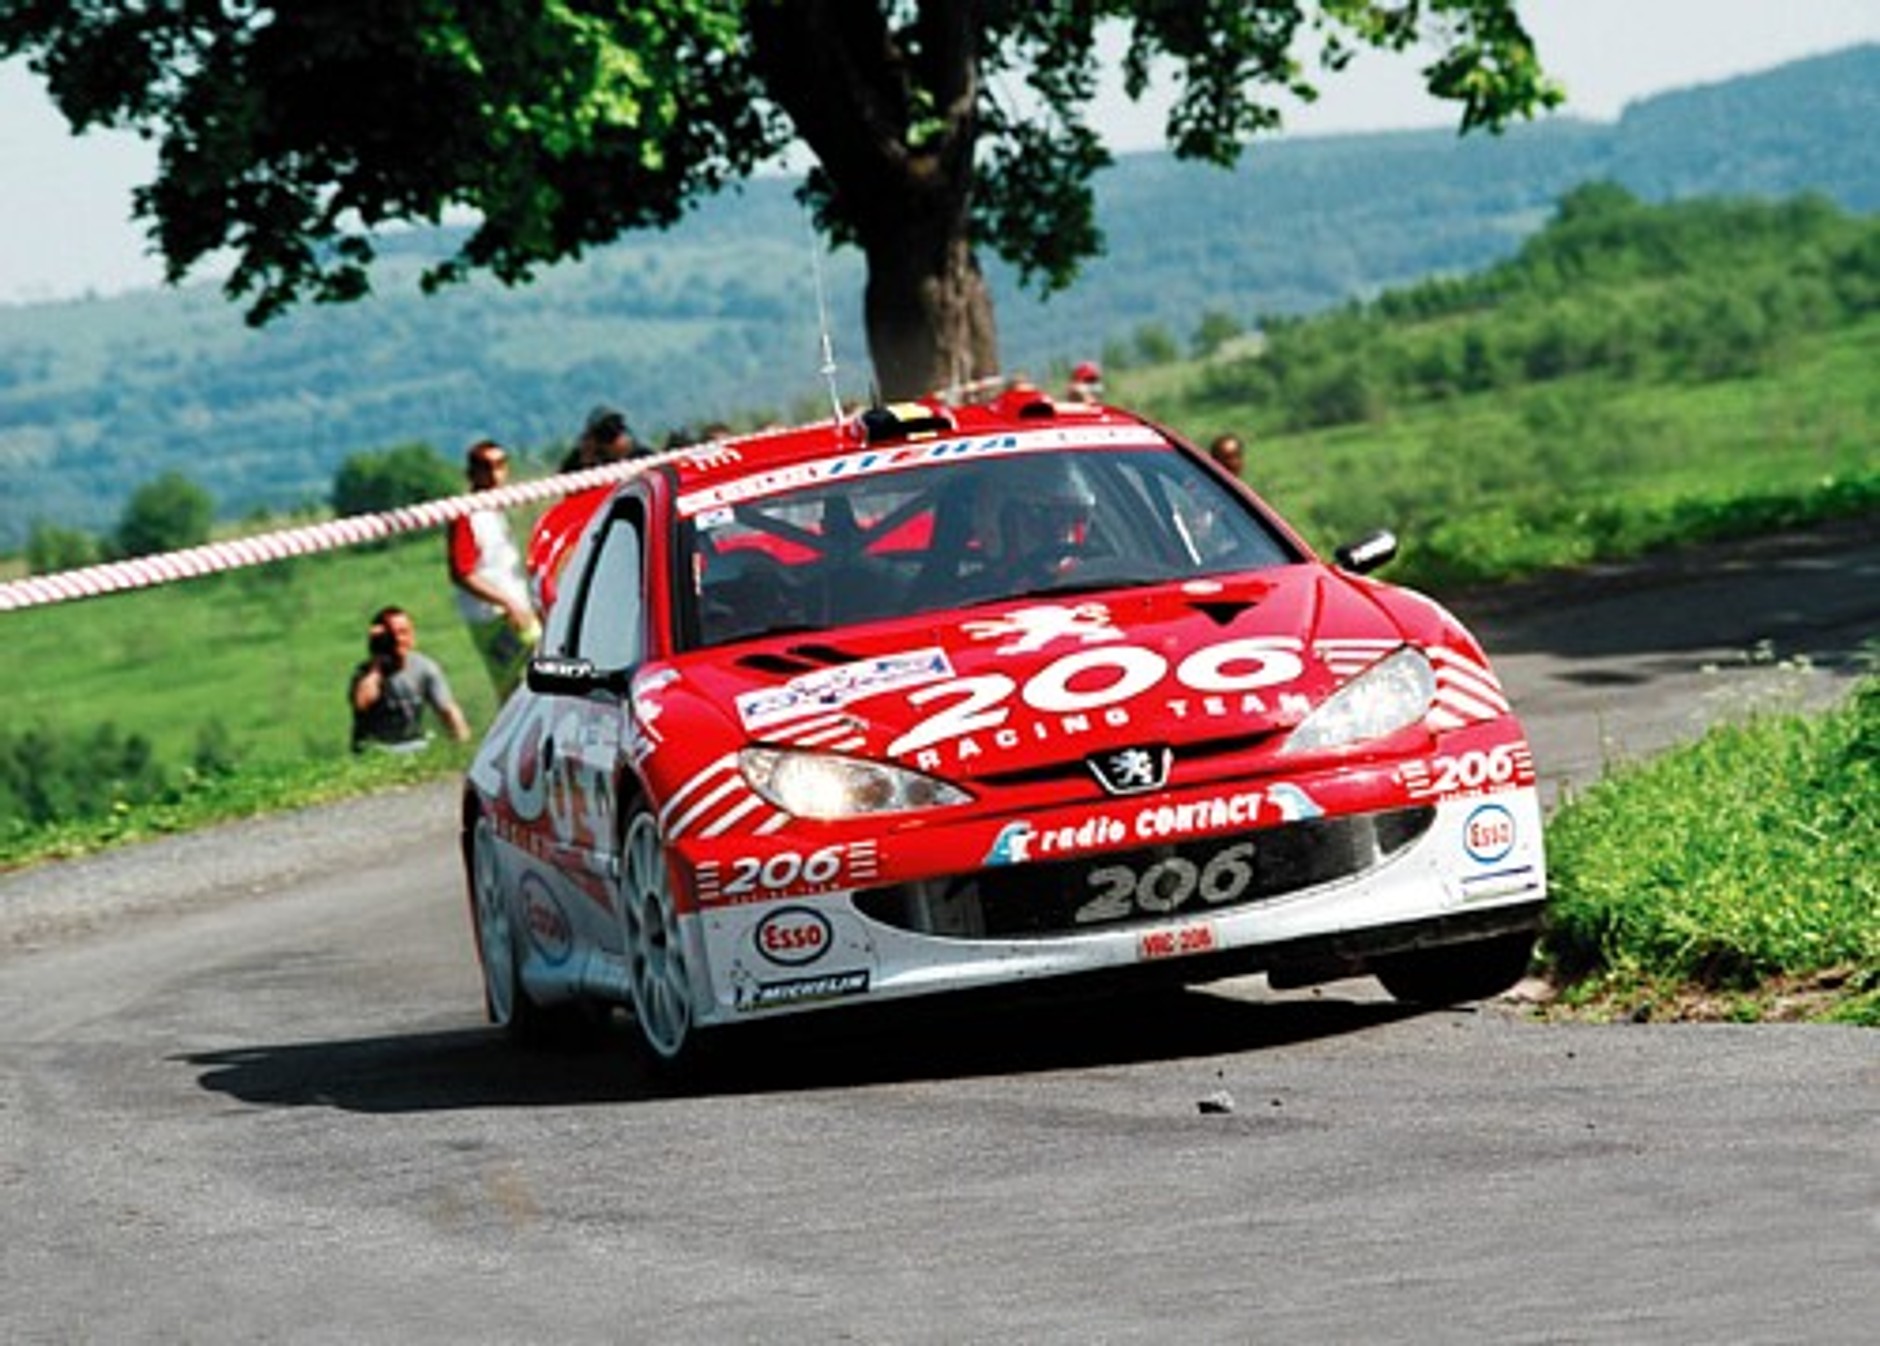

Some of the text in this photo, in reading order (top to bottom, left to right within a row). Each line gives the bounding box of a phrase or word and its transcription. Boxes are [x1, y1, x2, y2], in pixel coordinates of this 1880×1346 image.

[887, 637, 1304, 757] 206
[916, 693, 1312, 771] RACING TEAM
[1430, 743, 1516, 792] 206
[1041, 793, 1263, 851] radio CONTACT
[722, 844, 847, 895] 206
[1075, 843, 1255, 922] 206
[763, 924, 823, 950] Esso
